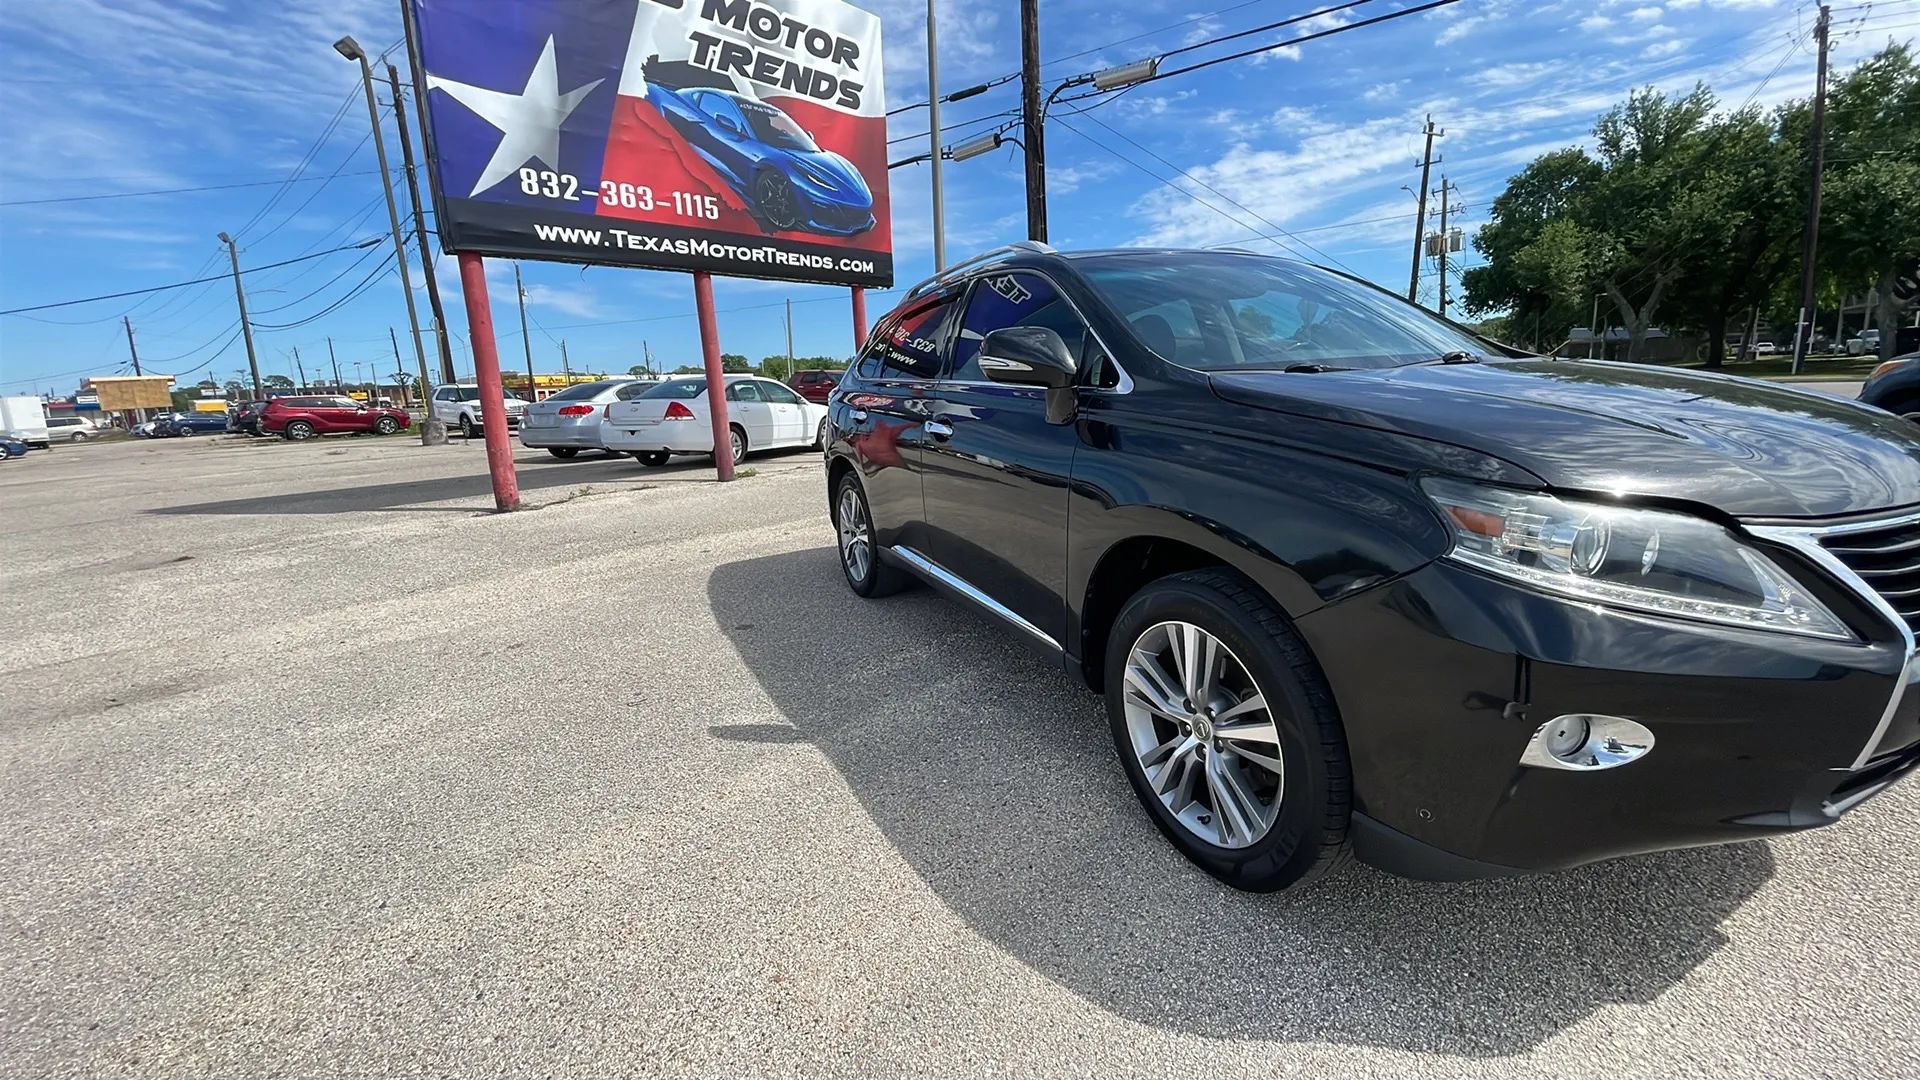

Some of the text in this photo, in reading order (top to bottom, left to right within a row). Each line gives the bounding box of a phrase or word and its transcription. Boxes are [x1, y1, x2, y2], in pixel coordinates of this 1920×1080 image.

[688, 31, 864, 110] TRENDS
[700, 0, 860, 71] MOTOR
[519, 167, 719, 220] 832-363-1115
